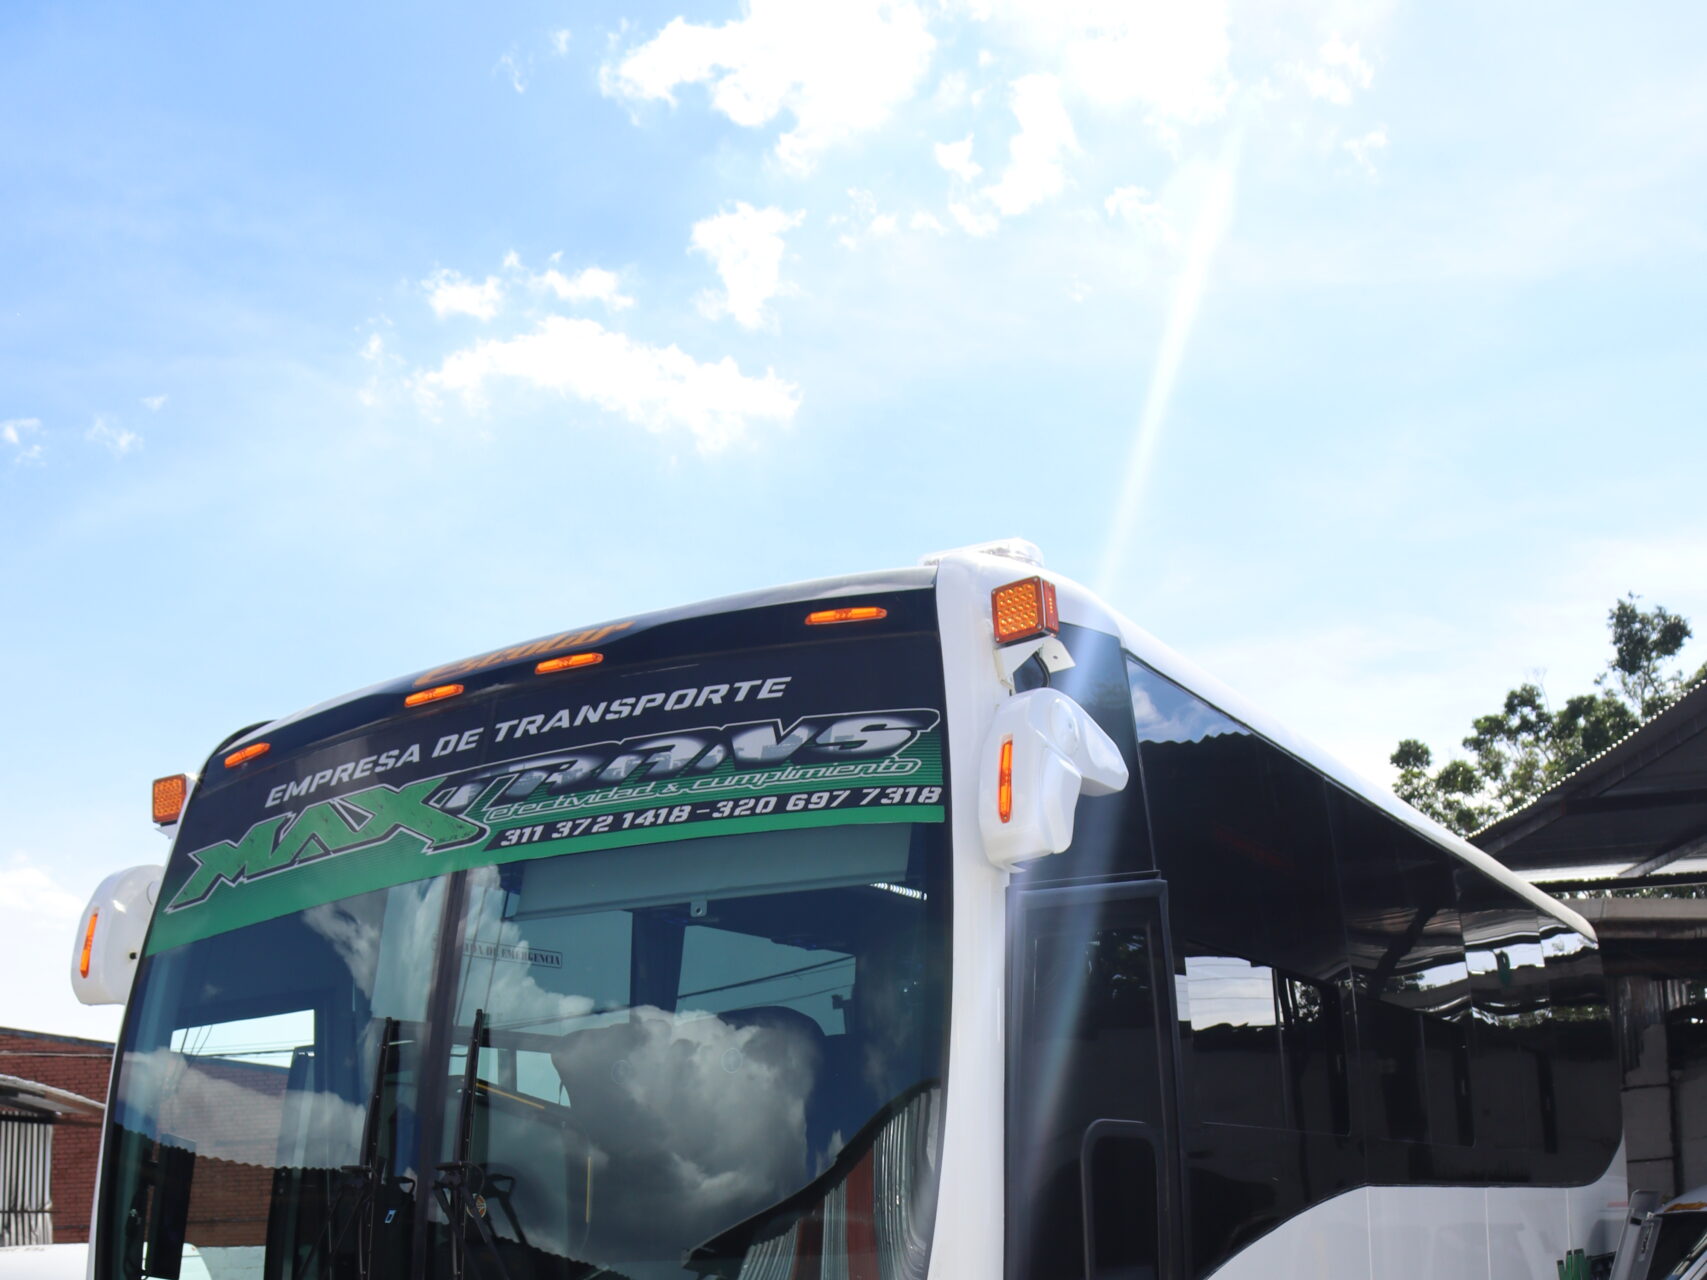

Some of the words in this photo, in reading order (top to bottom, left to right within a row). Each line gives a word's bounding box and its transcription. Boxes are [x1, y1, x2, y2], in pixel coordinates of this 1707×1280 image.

[264, 743, 421, 808] EMPRESA
[431, 727, 484, 759] DE
[494, 676, 792, 743] TRANSPORTE
[486, 782, 656, 820] efectividad
[661, 783, 682, 794] &
[692, 758, 917, 789] cumplimiento
[164, 775, 490, 913] MAX
[500, 824, 545, 847] 311
[551, 814, 614, 838] 372
[785, 789, 851, 811] 697
[860, 786, 942, 805] 7318
